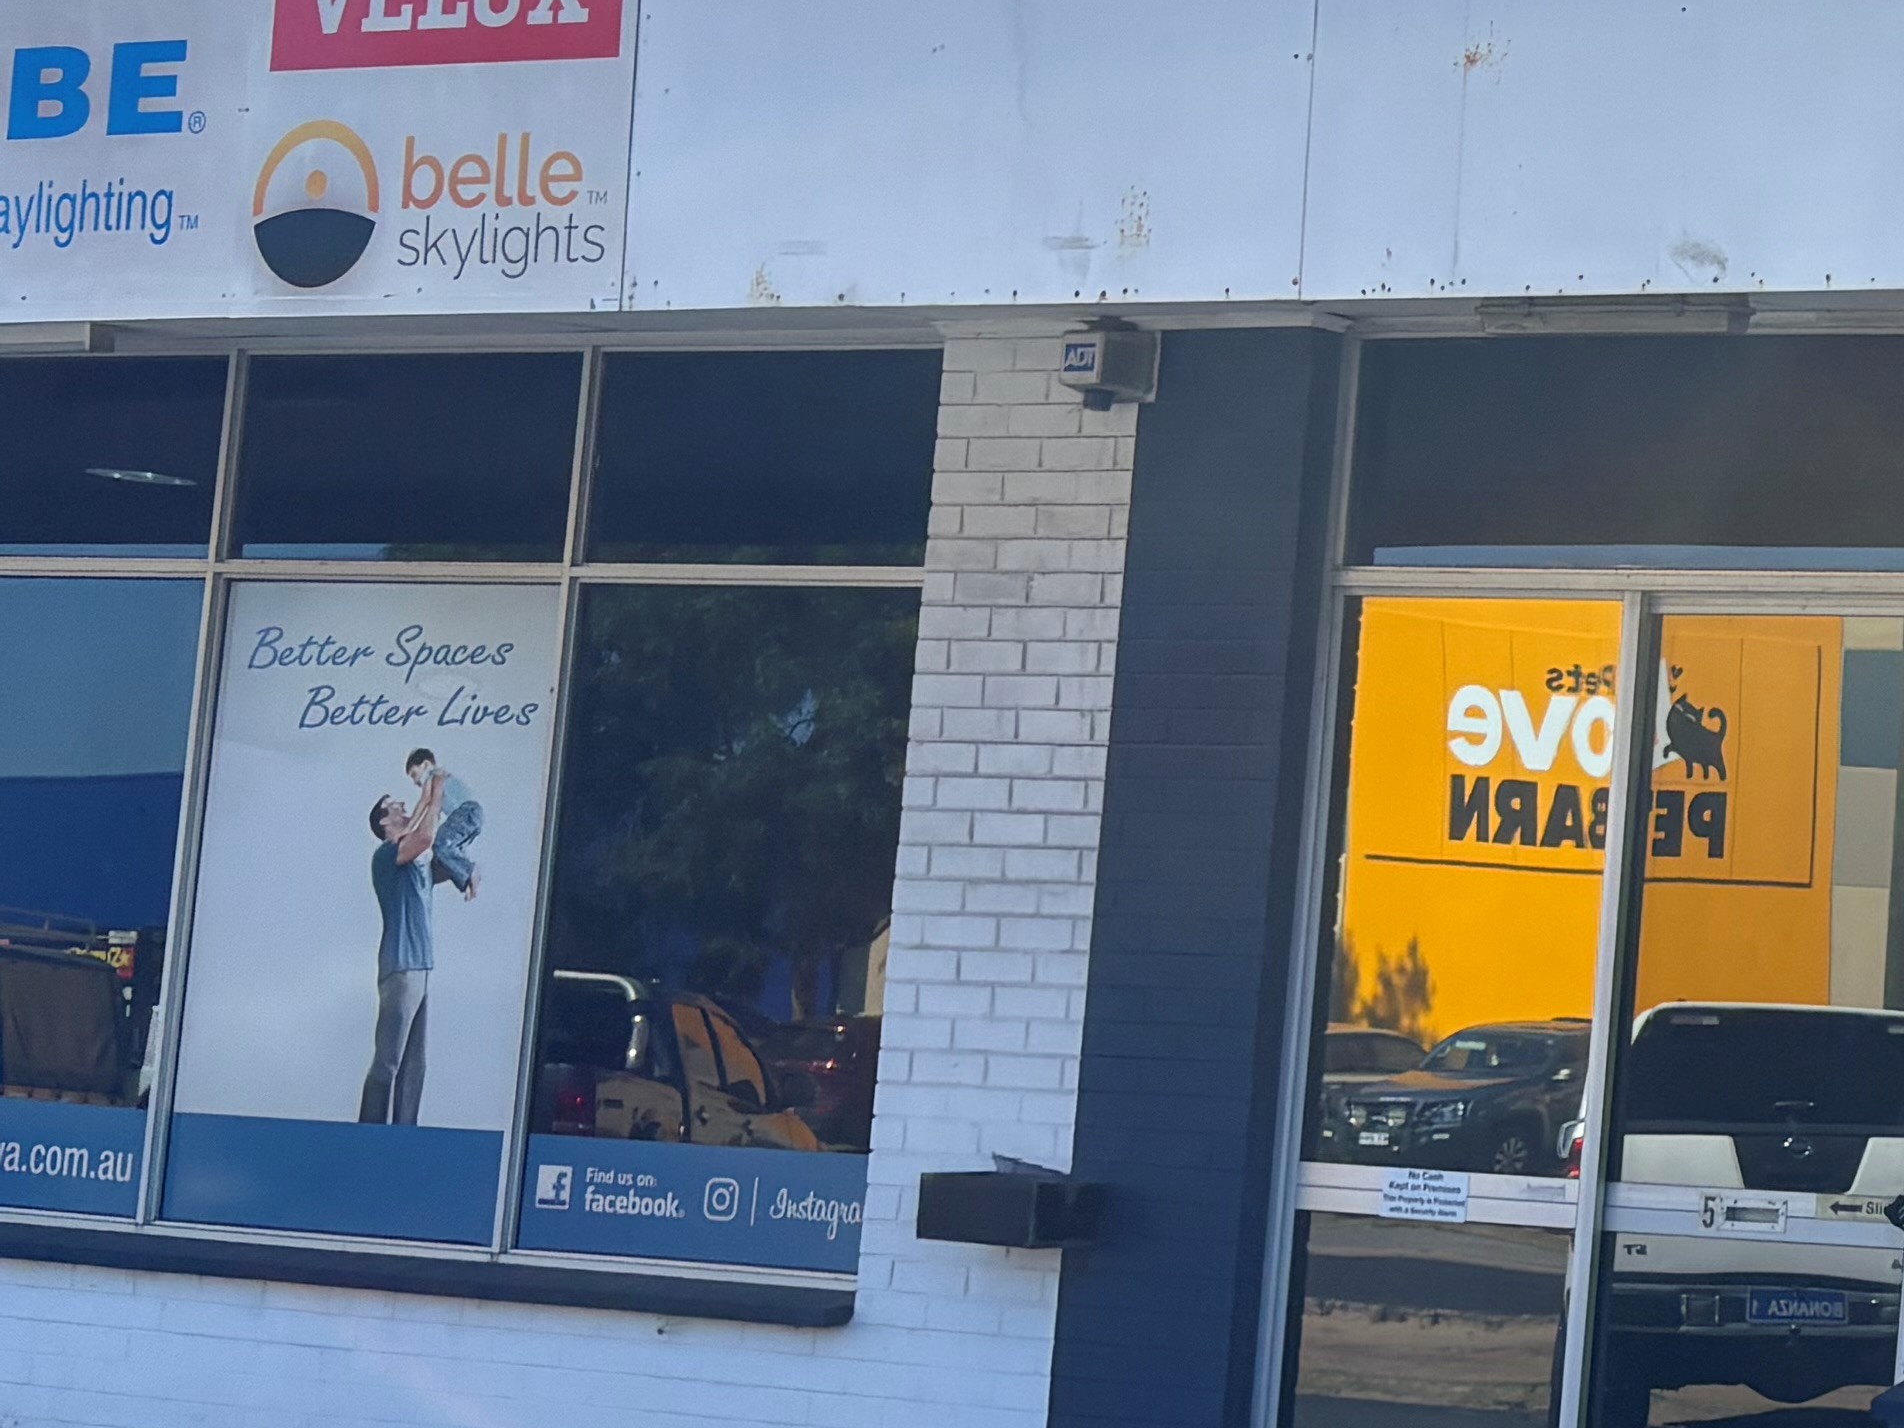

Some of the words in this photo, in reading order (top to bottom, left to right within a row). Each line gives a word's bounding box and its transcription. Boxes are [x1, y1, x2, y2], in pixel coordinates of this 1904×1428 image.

[401, 132, 584, 209] belle
[396, 212, 606, 279] skylights
[1064, 347, 1097, 368] ADT
[248, 626, 375, 674] Better
[384, 624, 515, 683] Spaces
[298, 685, 430, 731] Better
[436, 685, 539, 729] Lives
[585, 1167, 614, 1186] Find
[617, 1172, 634, 1187] us
[769, 1188, 863, 1240] Instagra
[1701, 1196, 1716, 1229] 5
[1865, 1201, 1885, 1215] Sli
